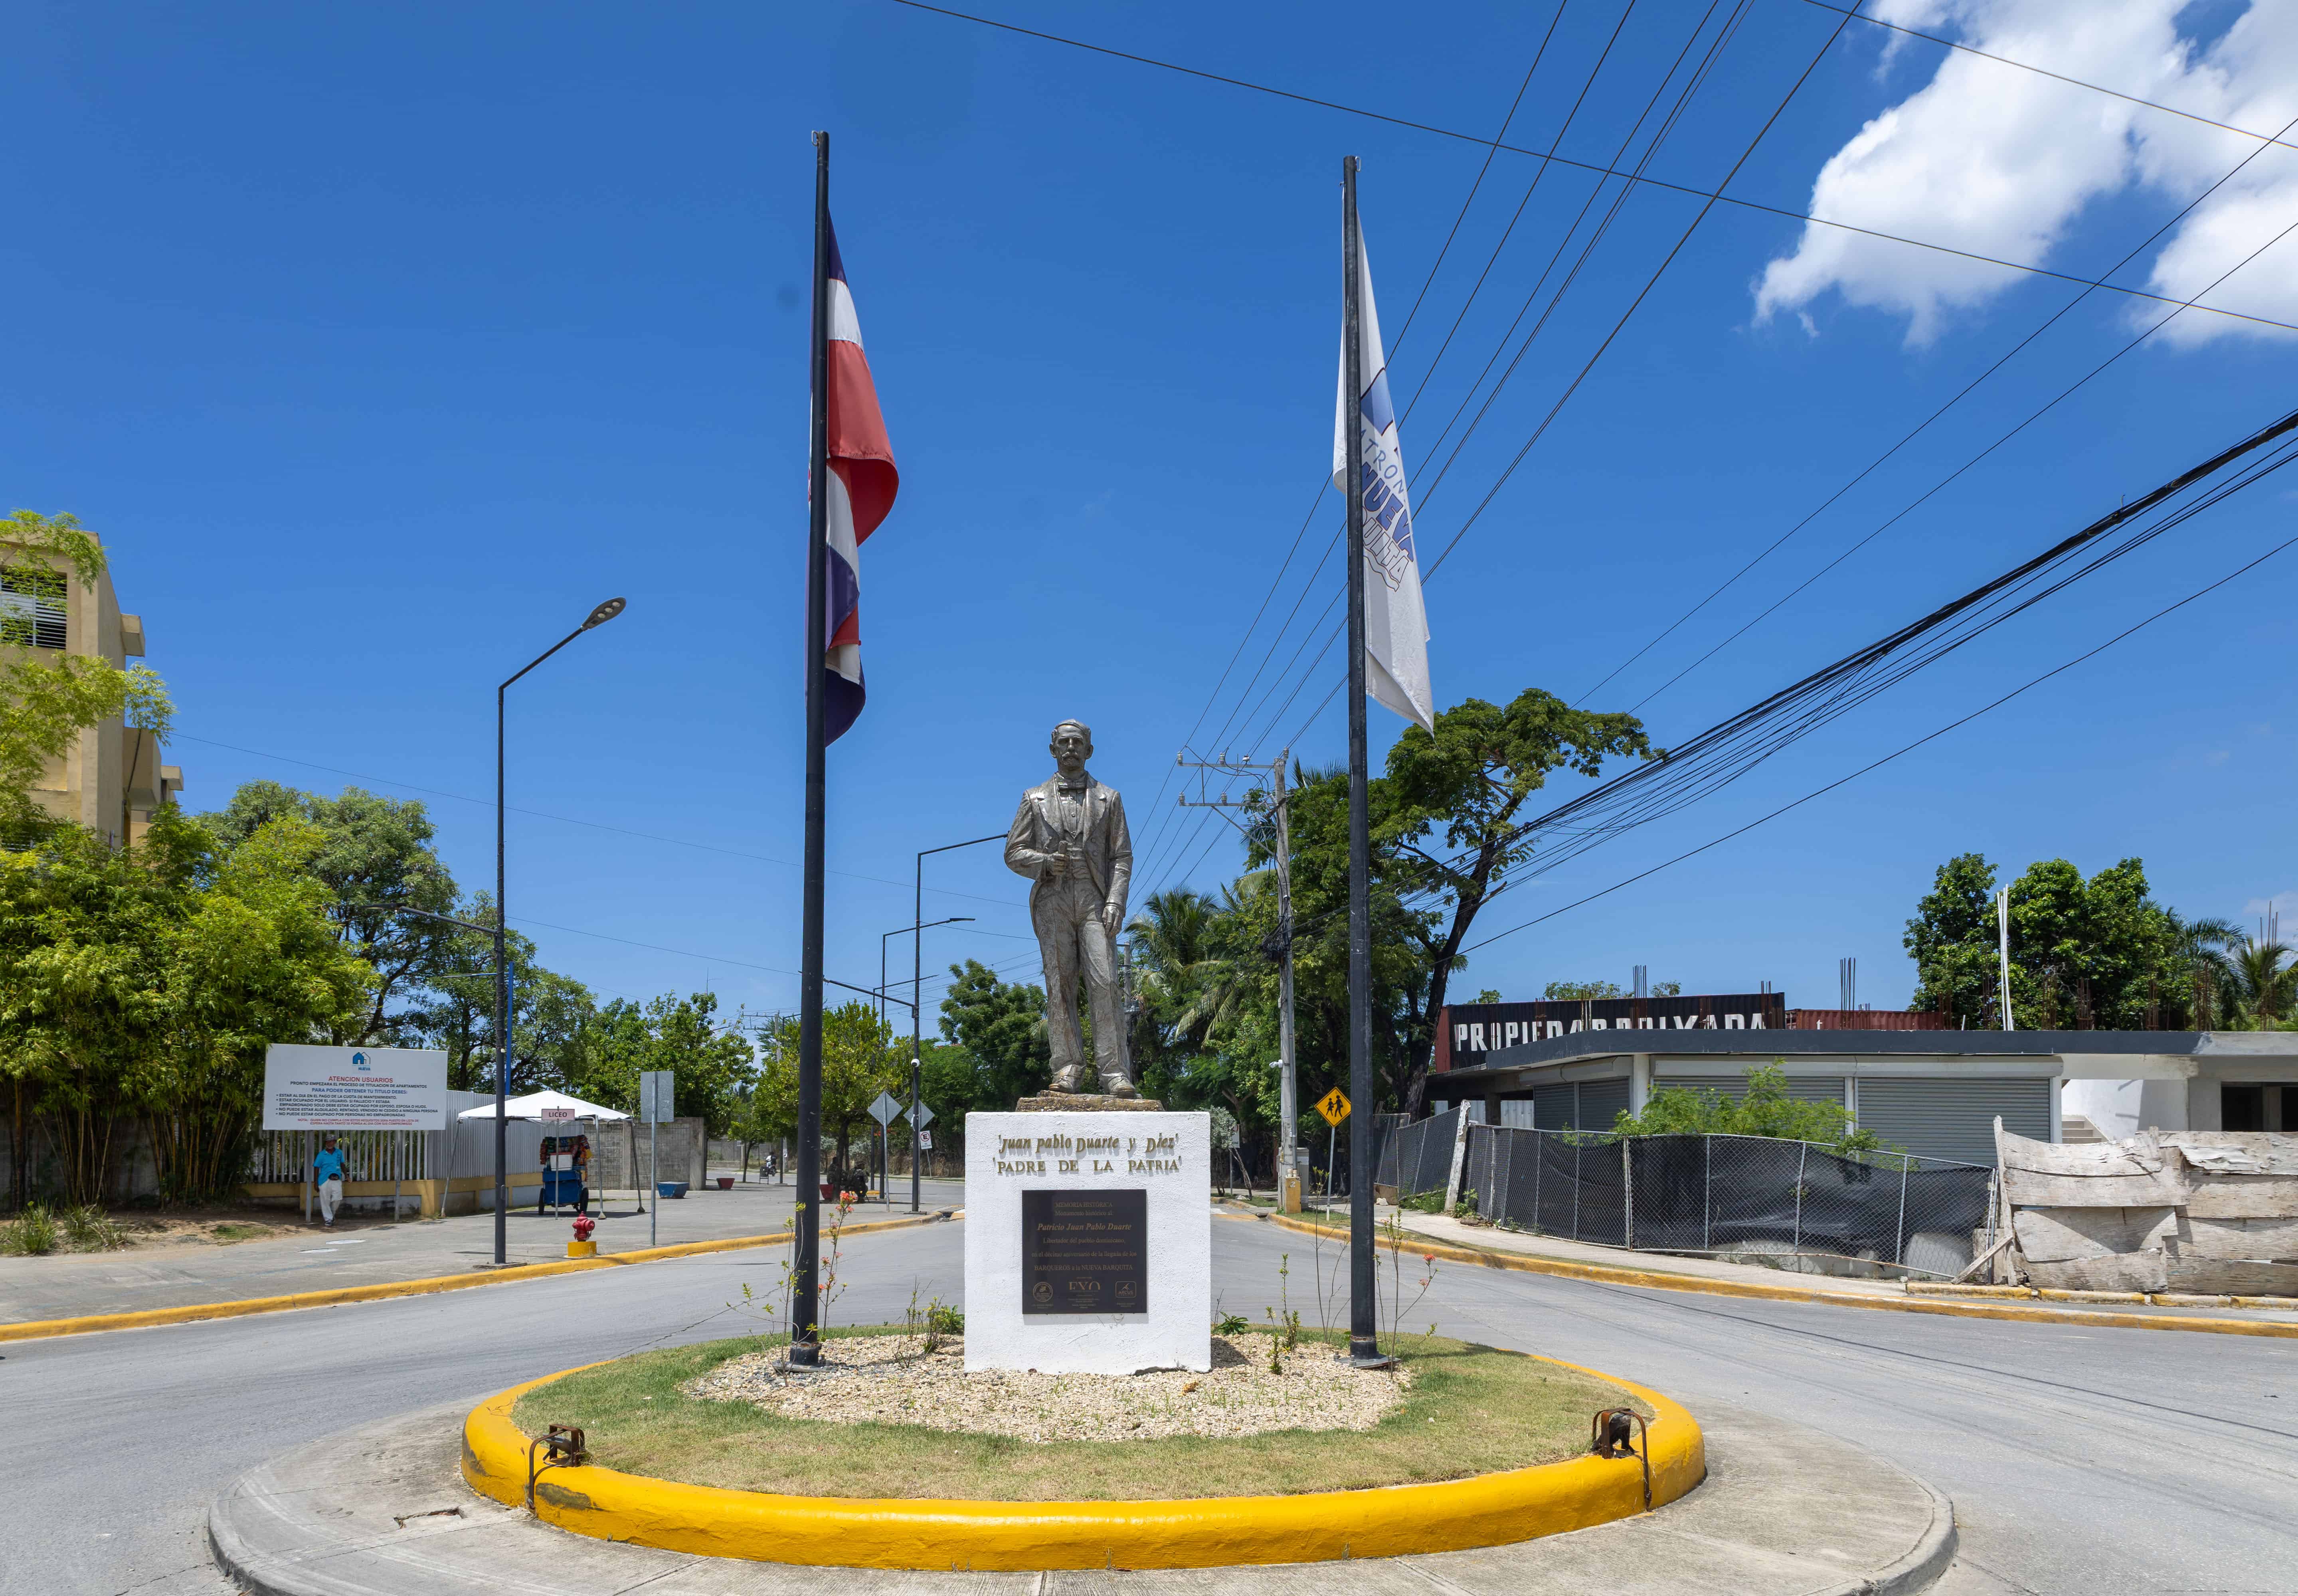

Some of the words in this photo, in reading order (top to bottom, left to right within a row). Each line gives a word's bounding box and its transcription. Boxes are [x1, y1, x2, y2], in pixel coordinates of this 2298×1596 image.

[1076, 1136, 1119, 1153] Duarte
[1127, 1138, 1135, 1152] y
[1058, 1160, 1079, 1171] DE
[1093, 1160, 1113, 1171] LA
